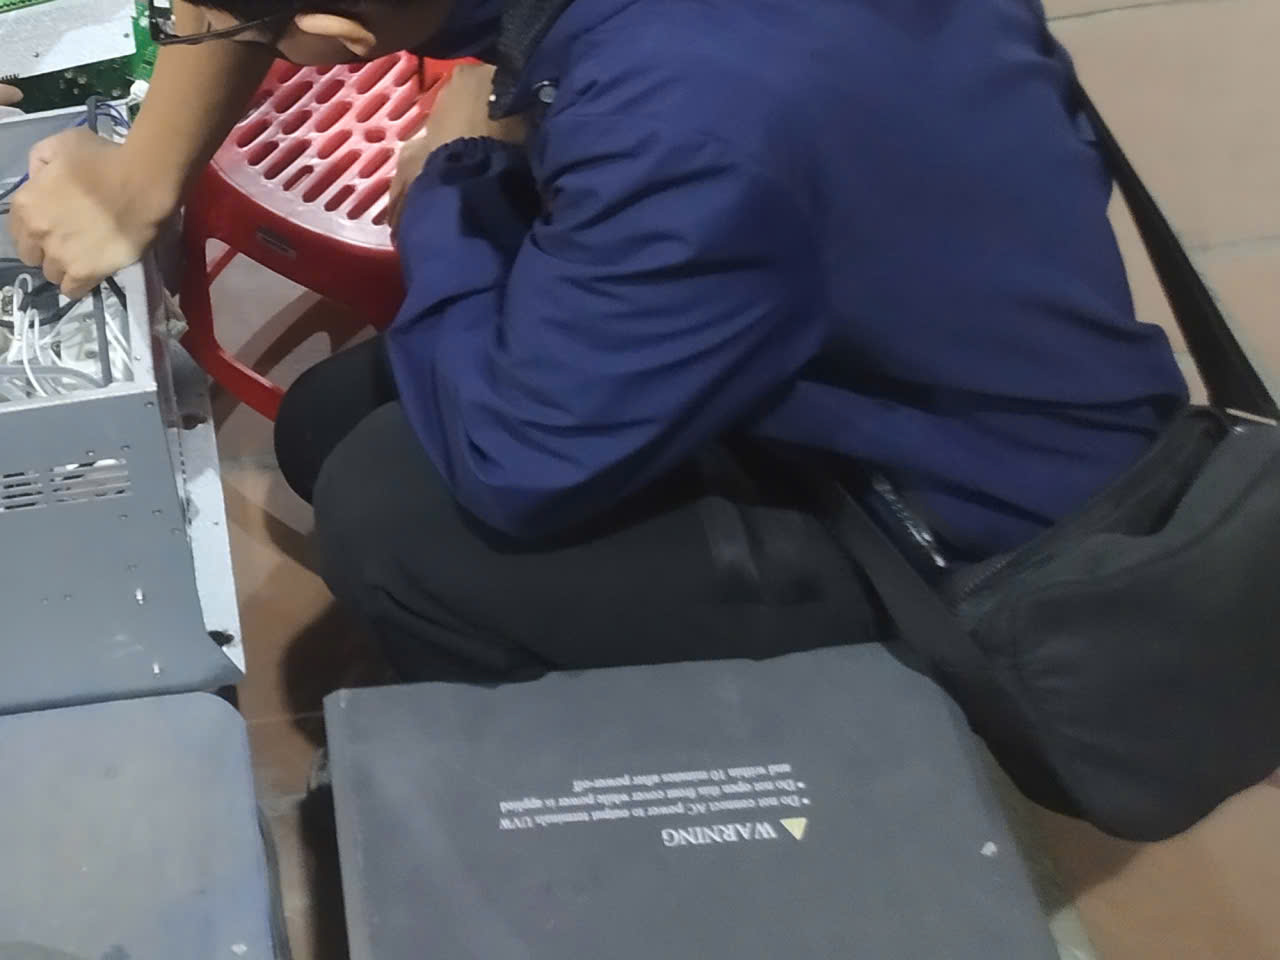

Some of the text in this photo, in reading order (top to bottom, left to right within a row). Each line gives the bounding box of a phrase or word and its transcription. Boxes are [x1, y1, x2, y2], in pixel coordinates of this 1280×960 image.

[710, 769, 726, 780] 10
[775, 779, 795, 791] Do
[780, 795, 801, 807] Do
[687, 802, 708, 815] AC
[499, 816, 534, 829] UVW
[661, 821, 777, 846] WARNING
